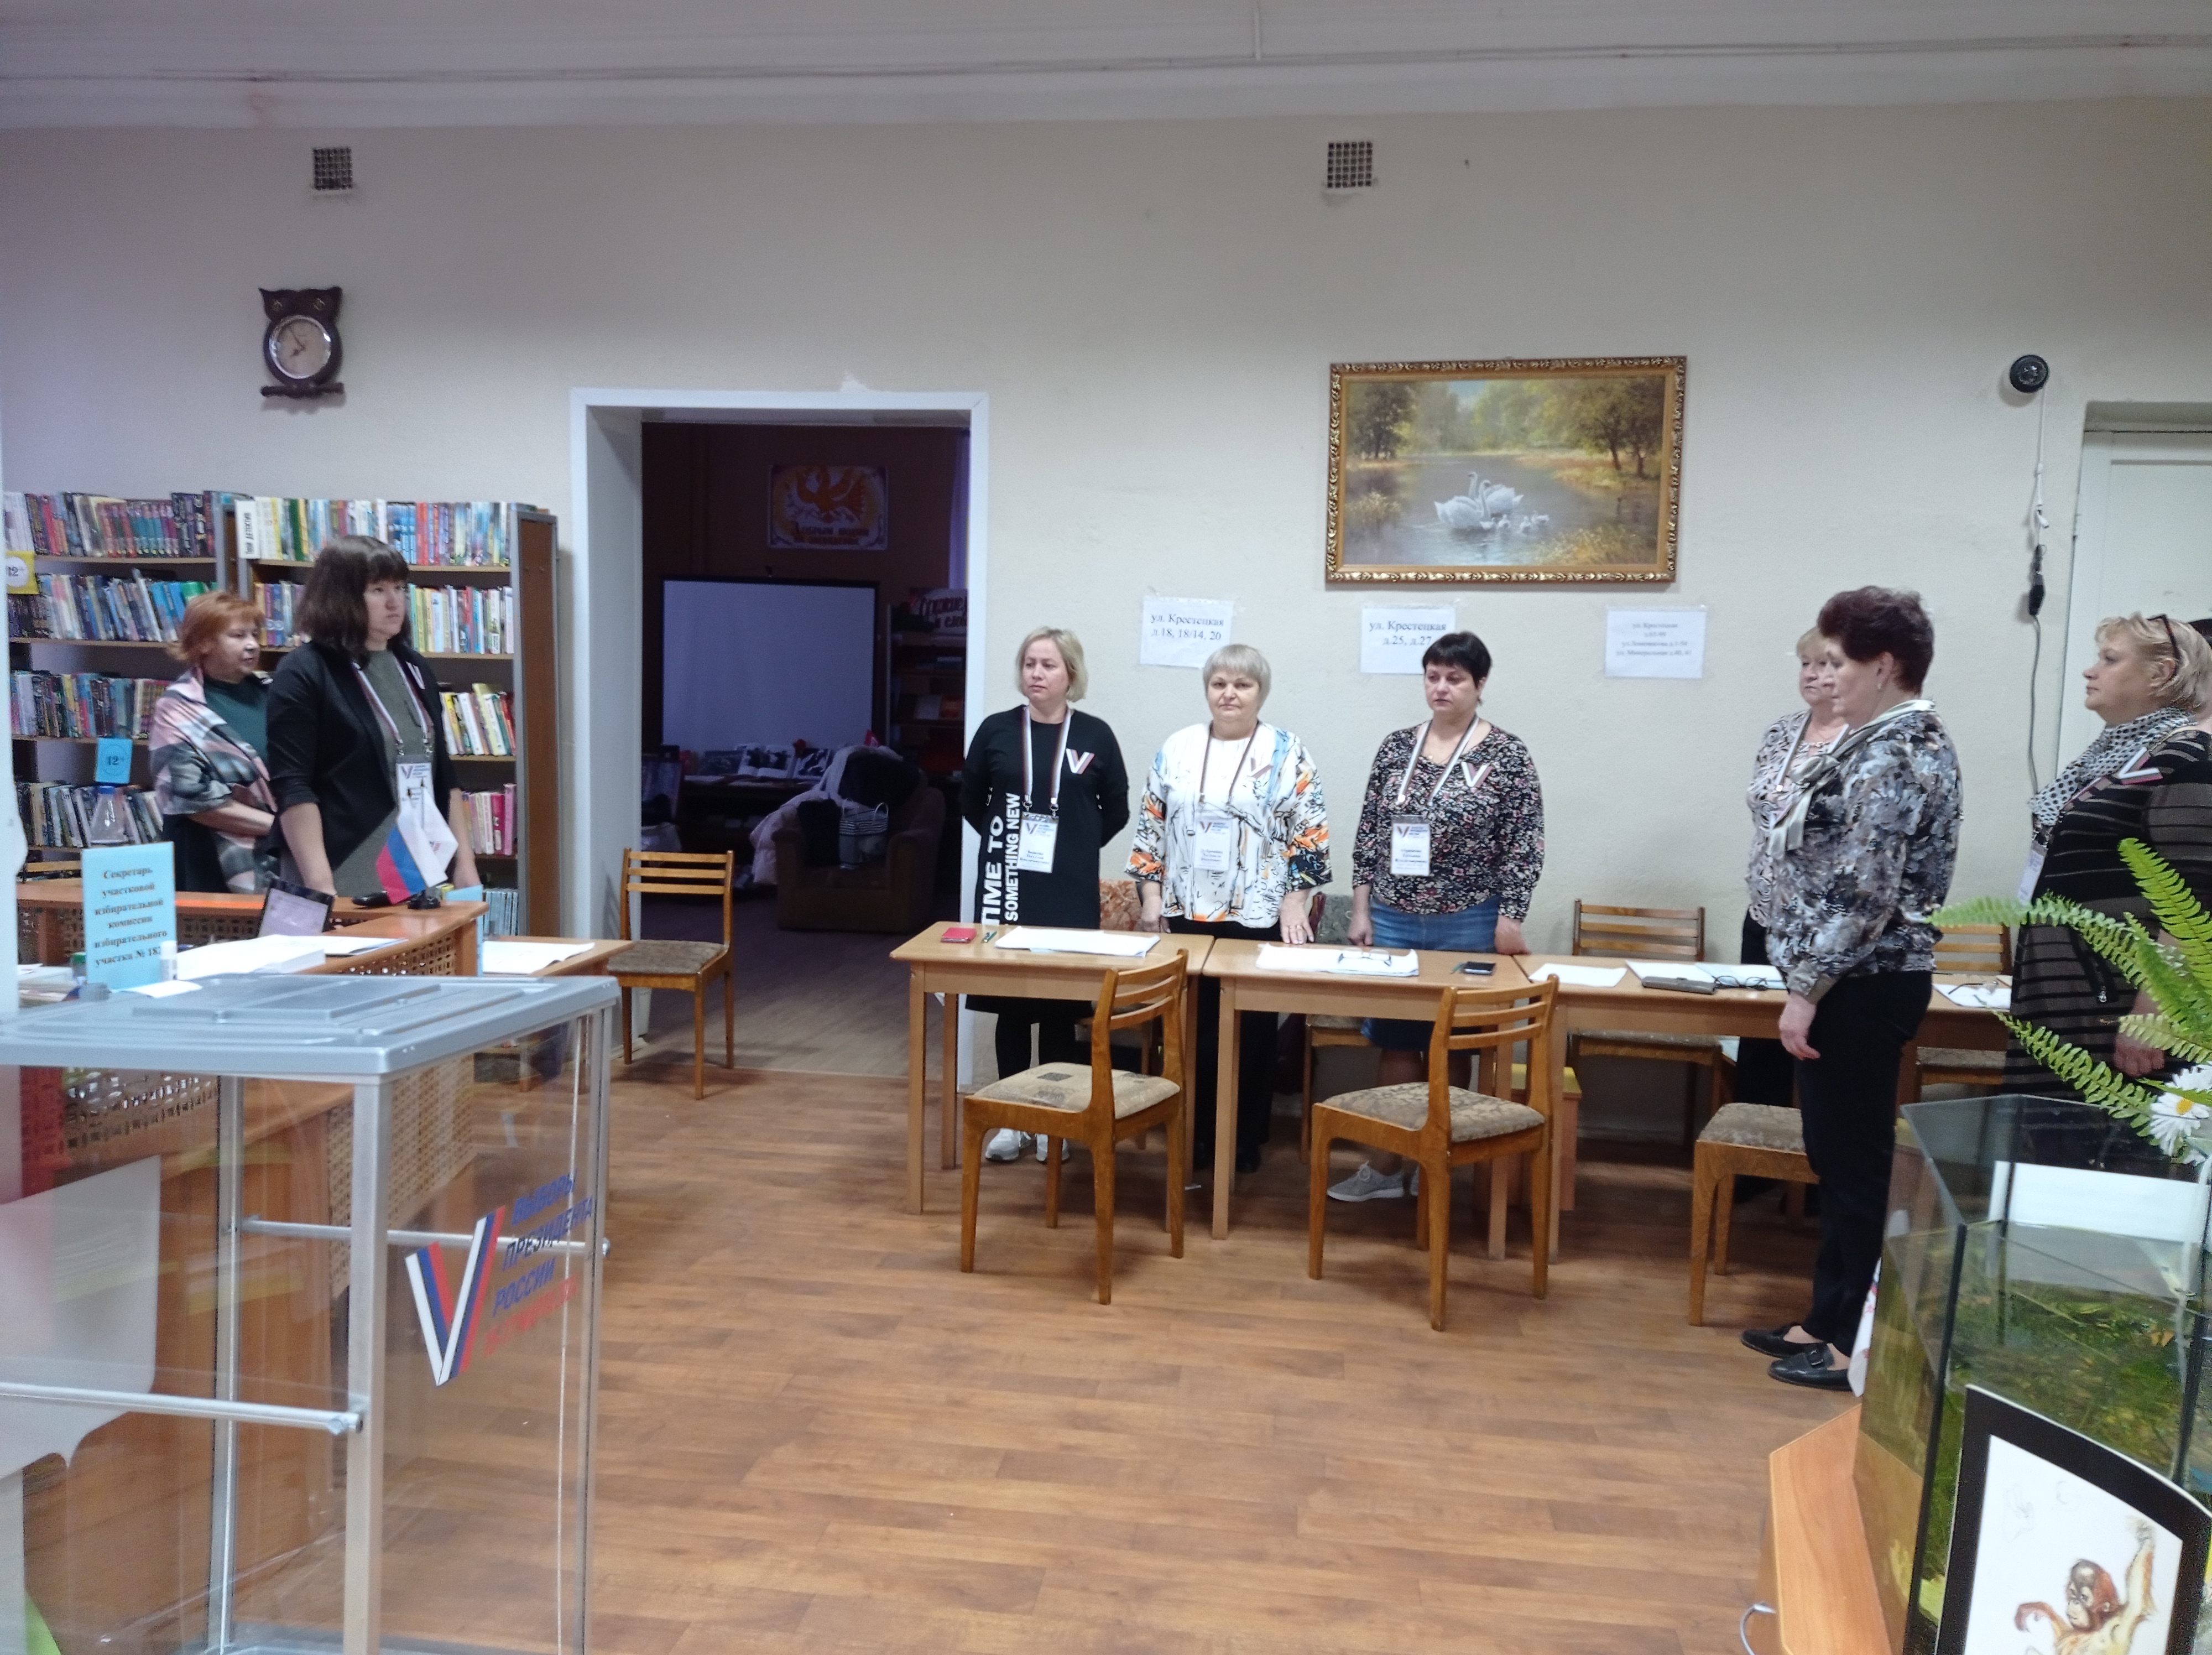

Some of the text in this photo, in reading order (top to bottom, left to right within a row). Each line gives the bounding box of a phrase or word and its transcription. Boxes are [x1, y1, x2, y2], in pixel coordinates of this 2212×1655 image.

[1151, 613, 1224, 626] ул. Крестецкая
[1369, 620, 1447, 632] ул. Крестецкая
[1210, 631, 1222, 640] 20
[1409, 636, 1432, 646] д.27
[1004, 792, 1021, 922] SOMETHING NEW
[103, 867, 153, 879] Секретарь
[981, 815, 1004, 926] TIME TO
[503, 1195, 593, 1272] ПРЕЗИДЕНТА
[493, 1257, 556, 1318] РОССИИ
